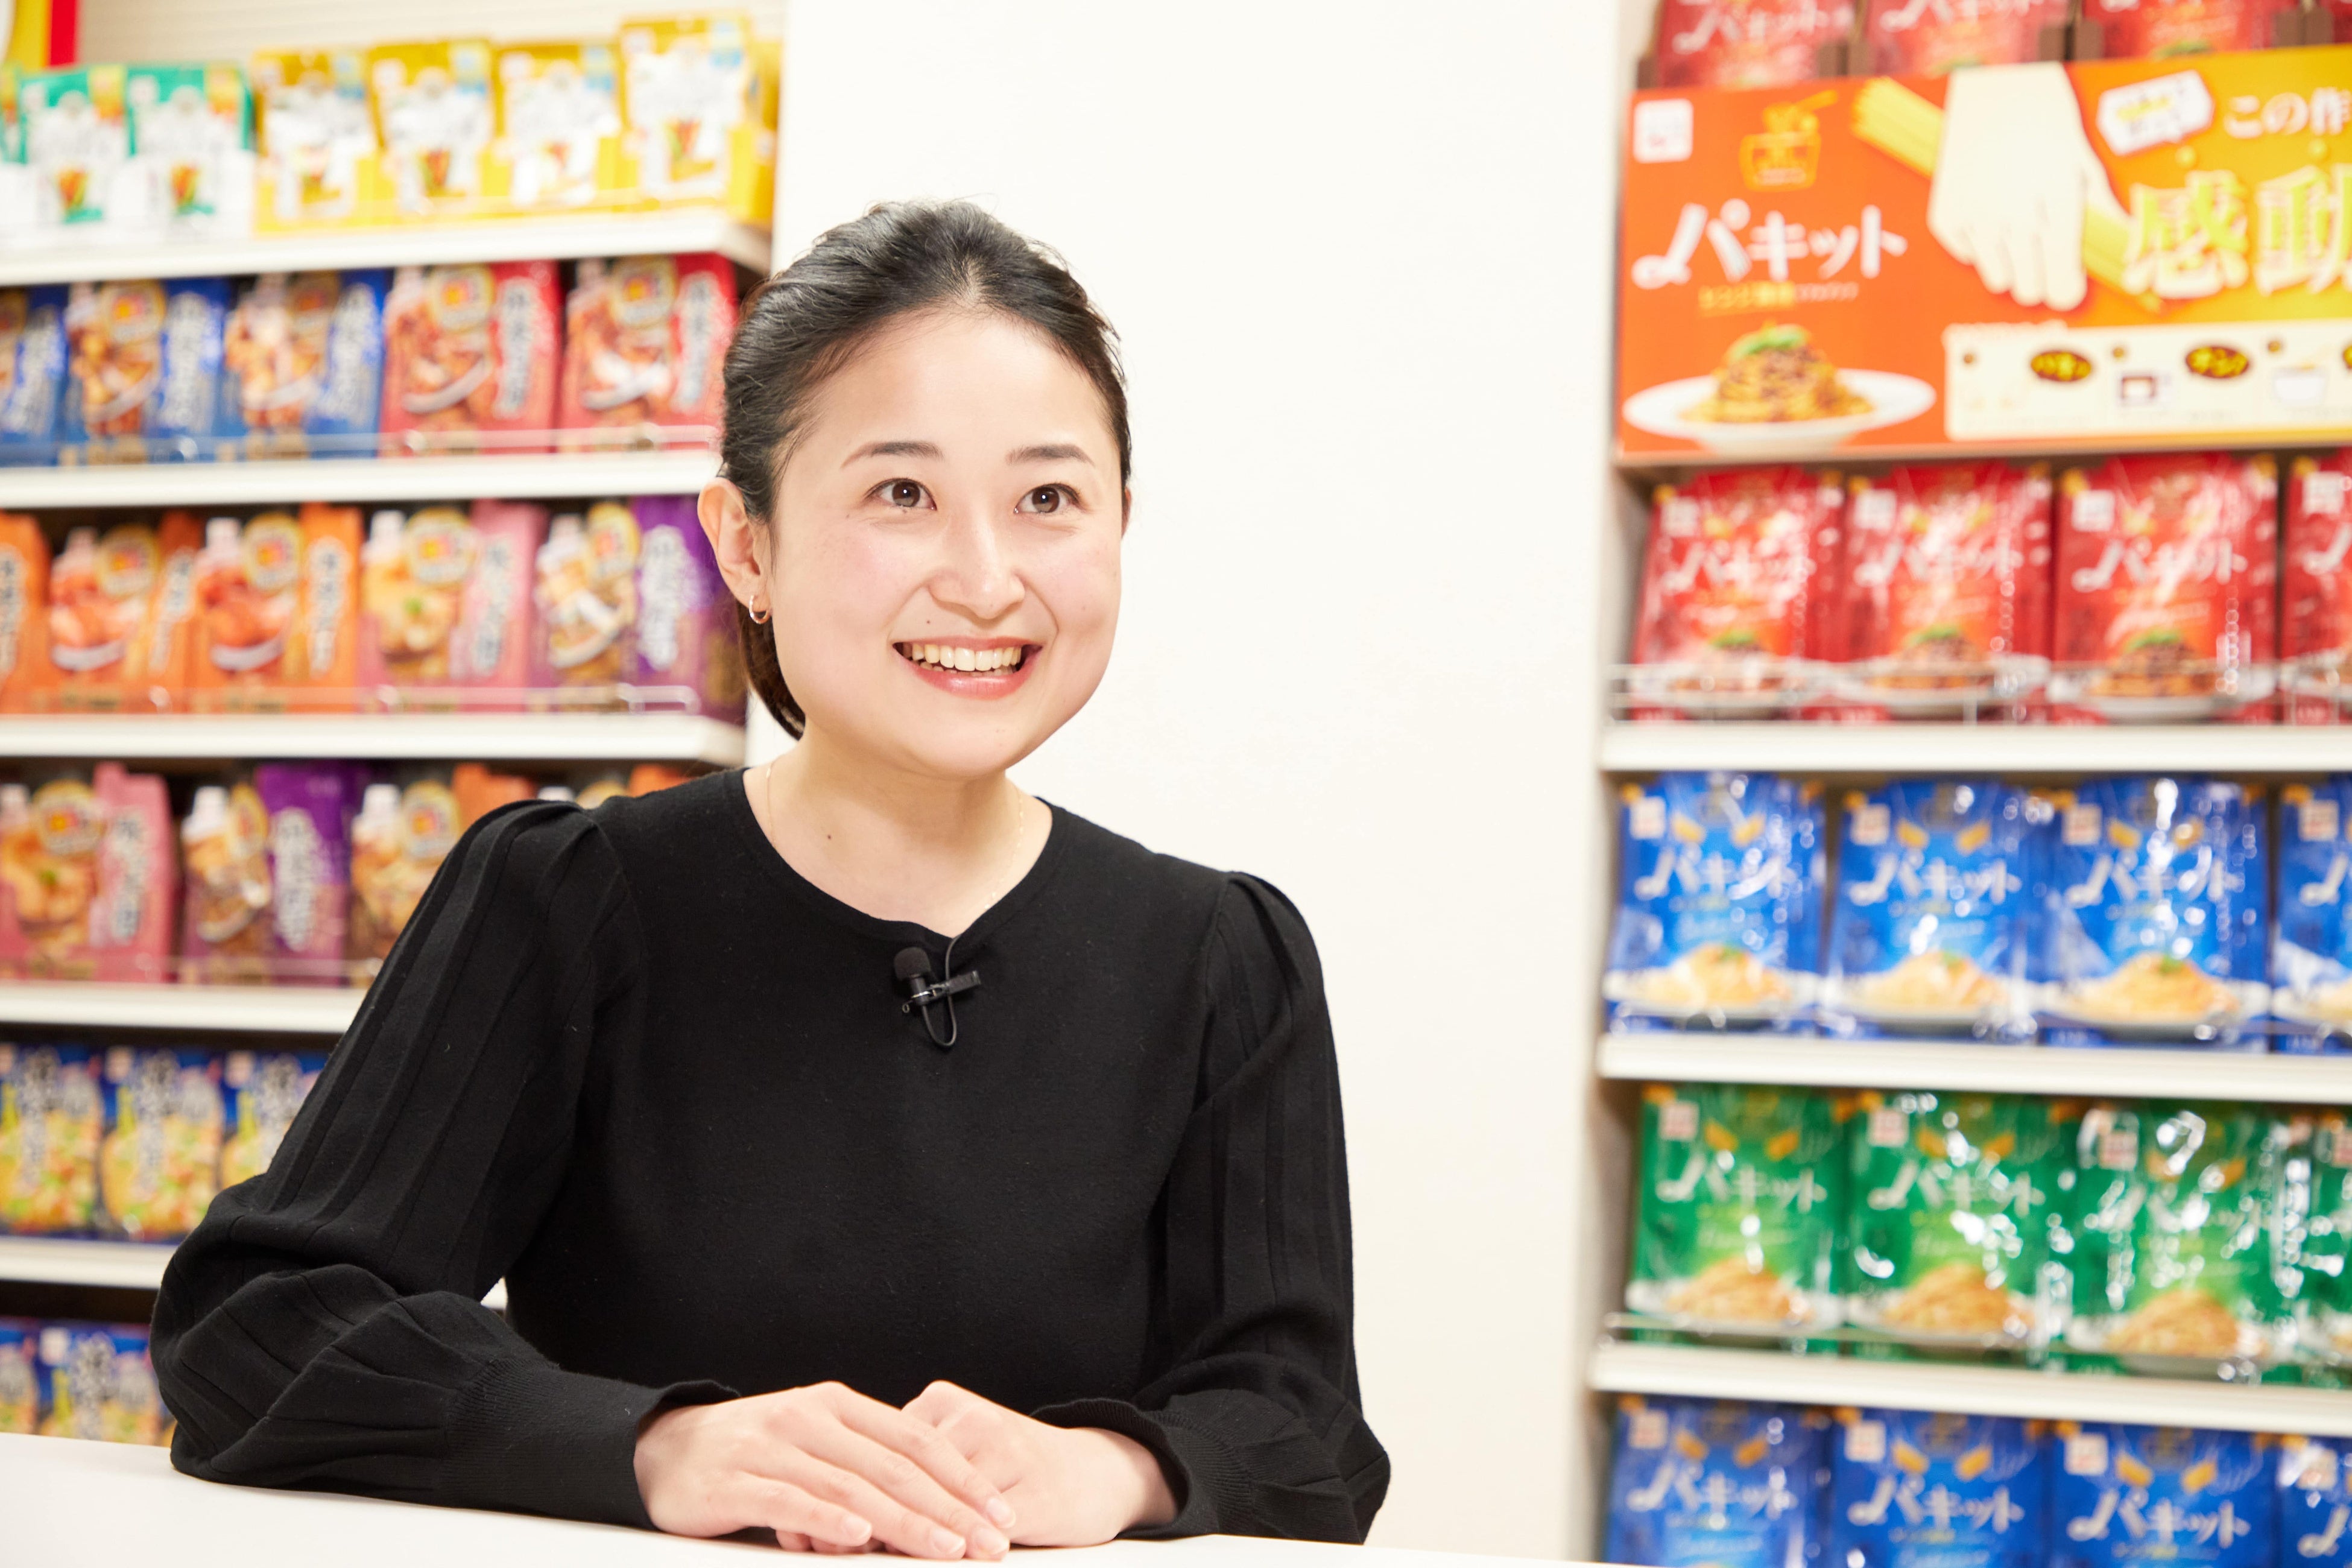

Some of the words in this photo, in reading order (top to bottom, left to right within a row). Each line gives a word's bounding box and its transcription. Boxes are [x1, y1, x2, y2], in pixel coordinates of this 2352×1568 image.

[2224, 86, 2352, 139] この作
[1632, 198, 1908, 289] パキット
[2122, 164, 2352, 299] 感動
[2073, 537, 2248, 591] パキット
[1848, 848, 2022, 906] パキット
[1655, 1149, 1827, 1215] パキット
[1626, 1461, 1796, 1520] パキット
[1847, 1474, 2024, 1534] パキット
[2067, 1487, 2251, 1549] パキット
